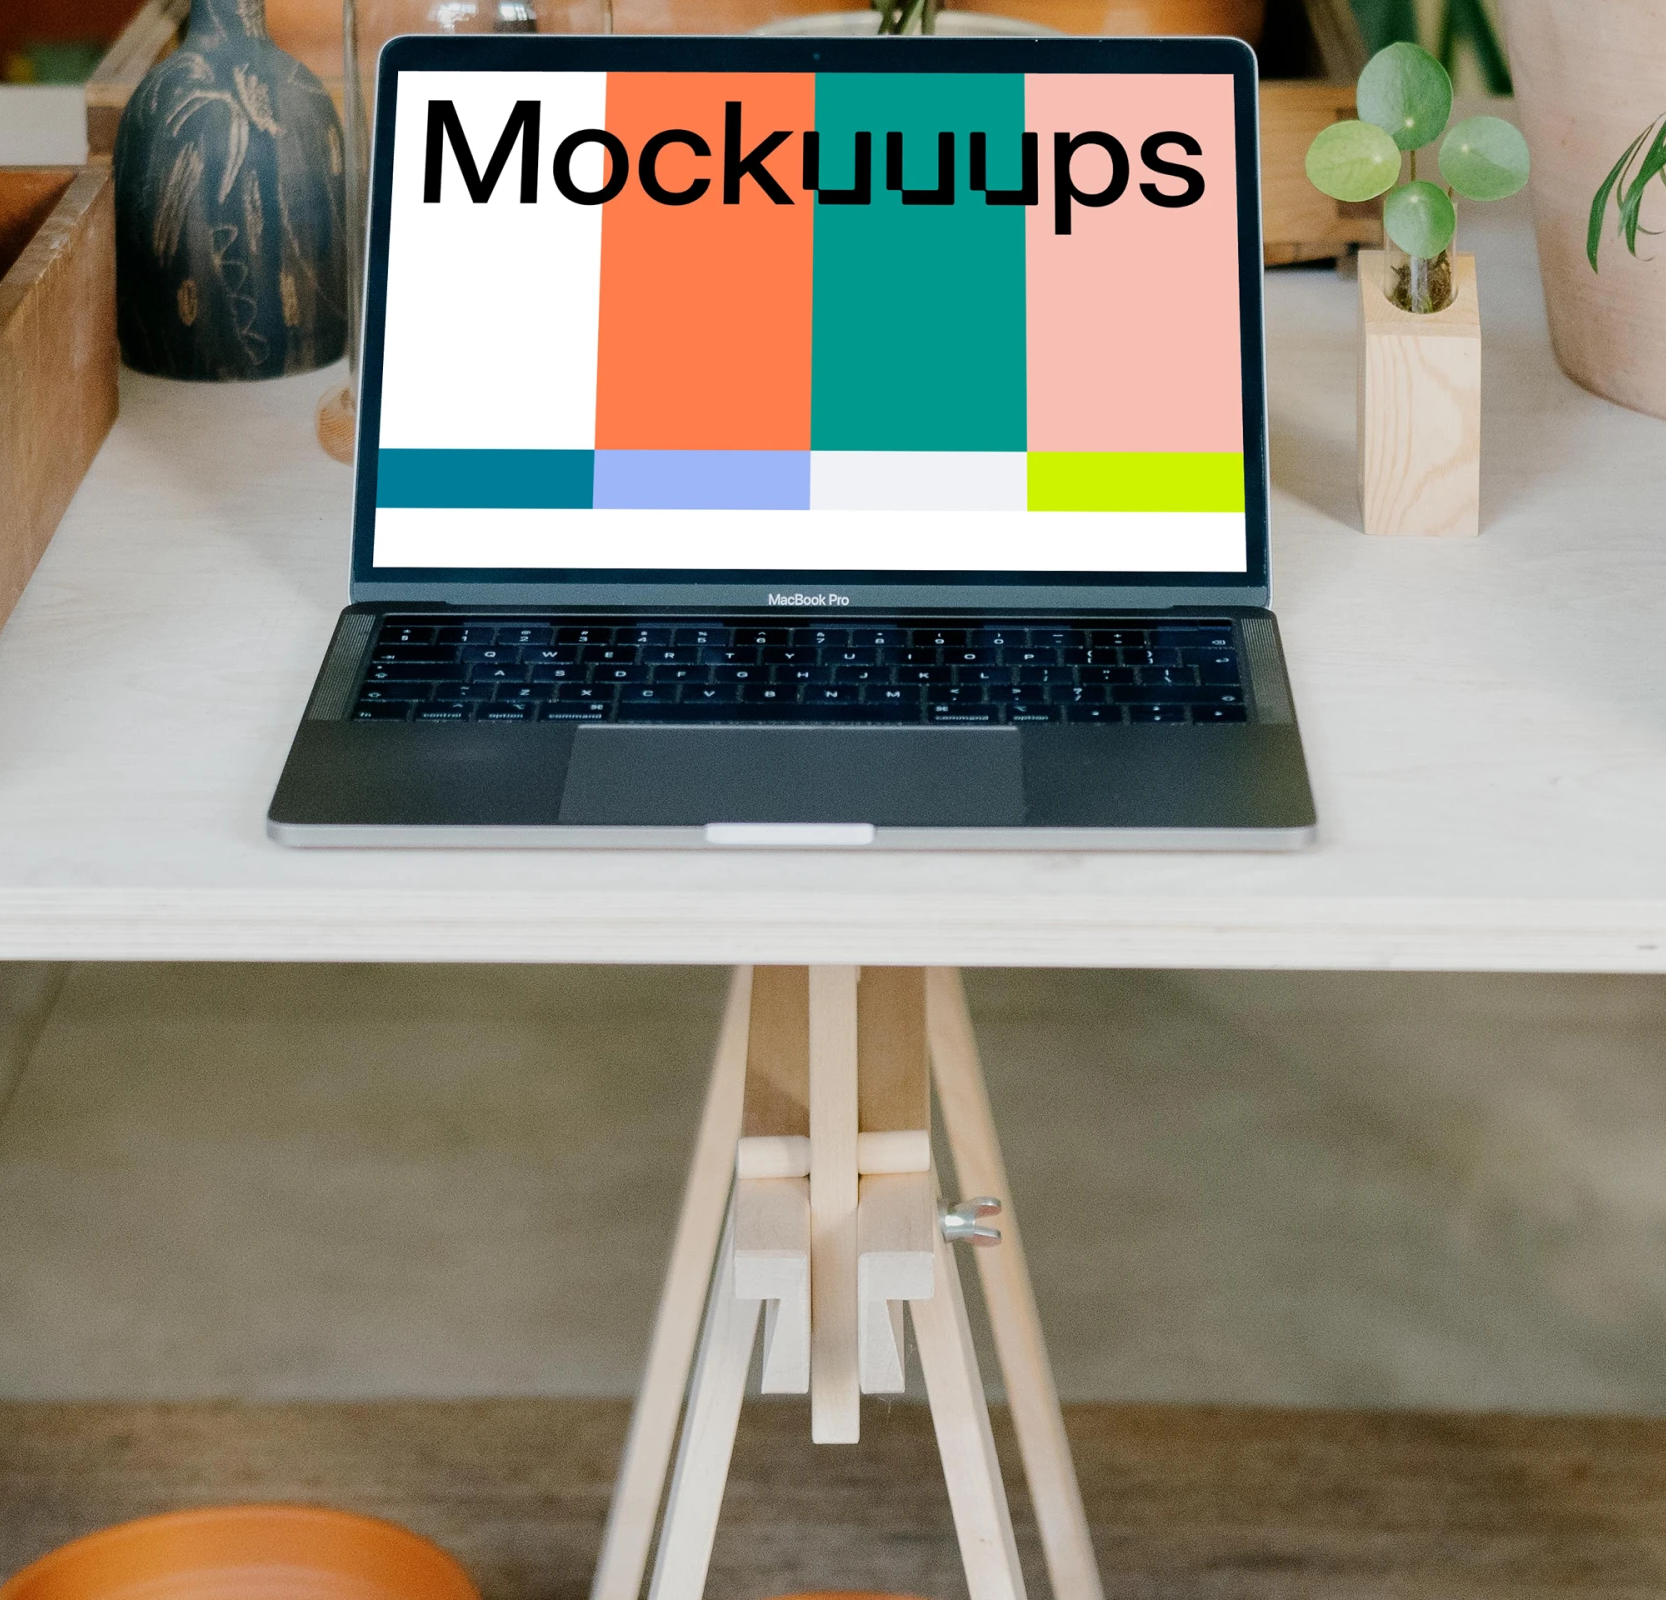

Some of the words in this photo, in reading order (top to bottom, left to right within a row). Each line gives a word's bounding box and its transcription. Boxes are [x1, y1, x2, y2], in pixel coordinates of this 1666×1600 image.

[423, 99, 1206, 236] Mockuuups
[768, 593, 826, 606] MacBook
[829, 593, 850, 606] Pro
